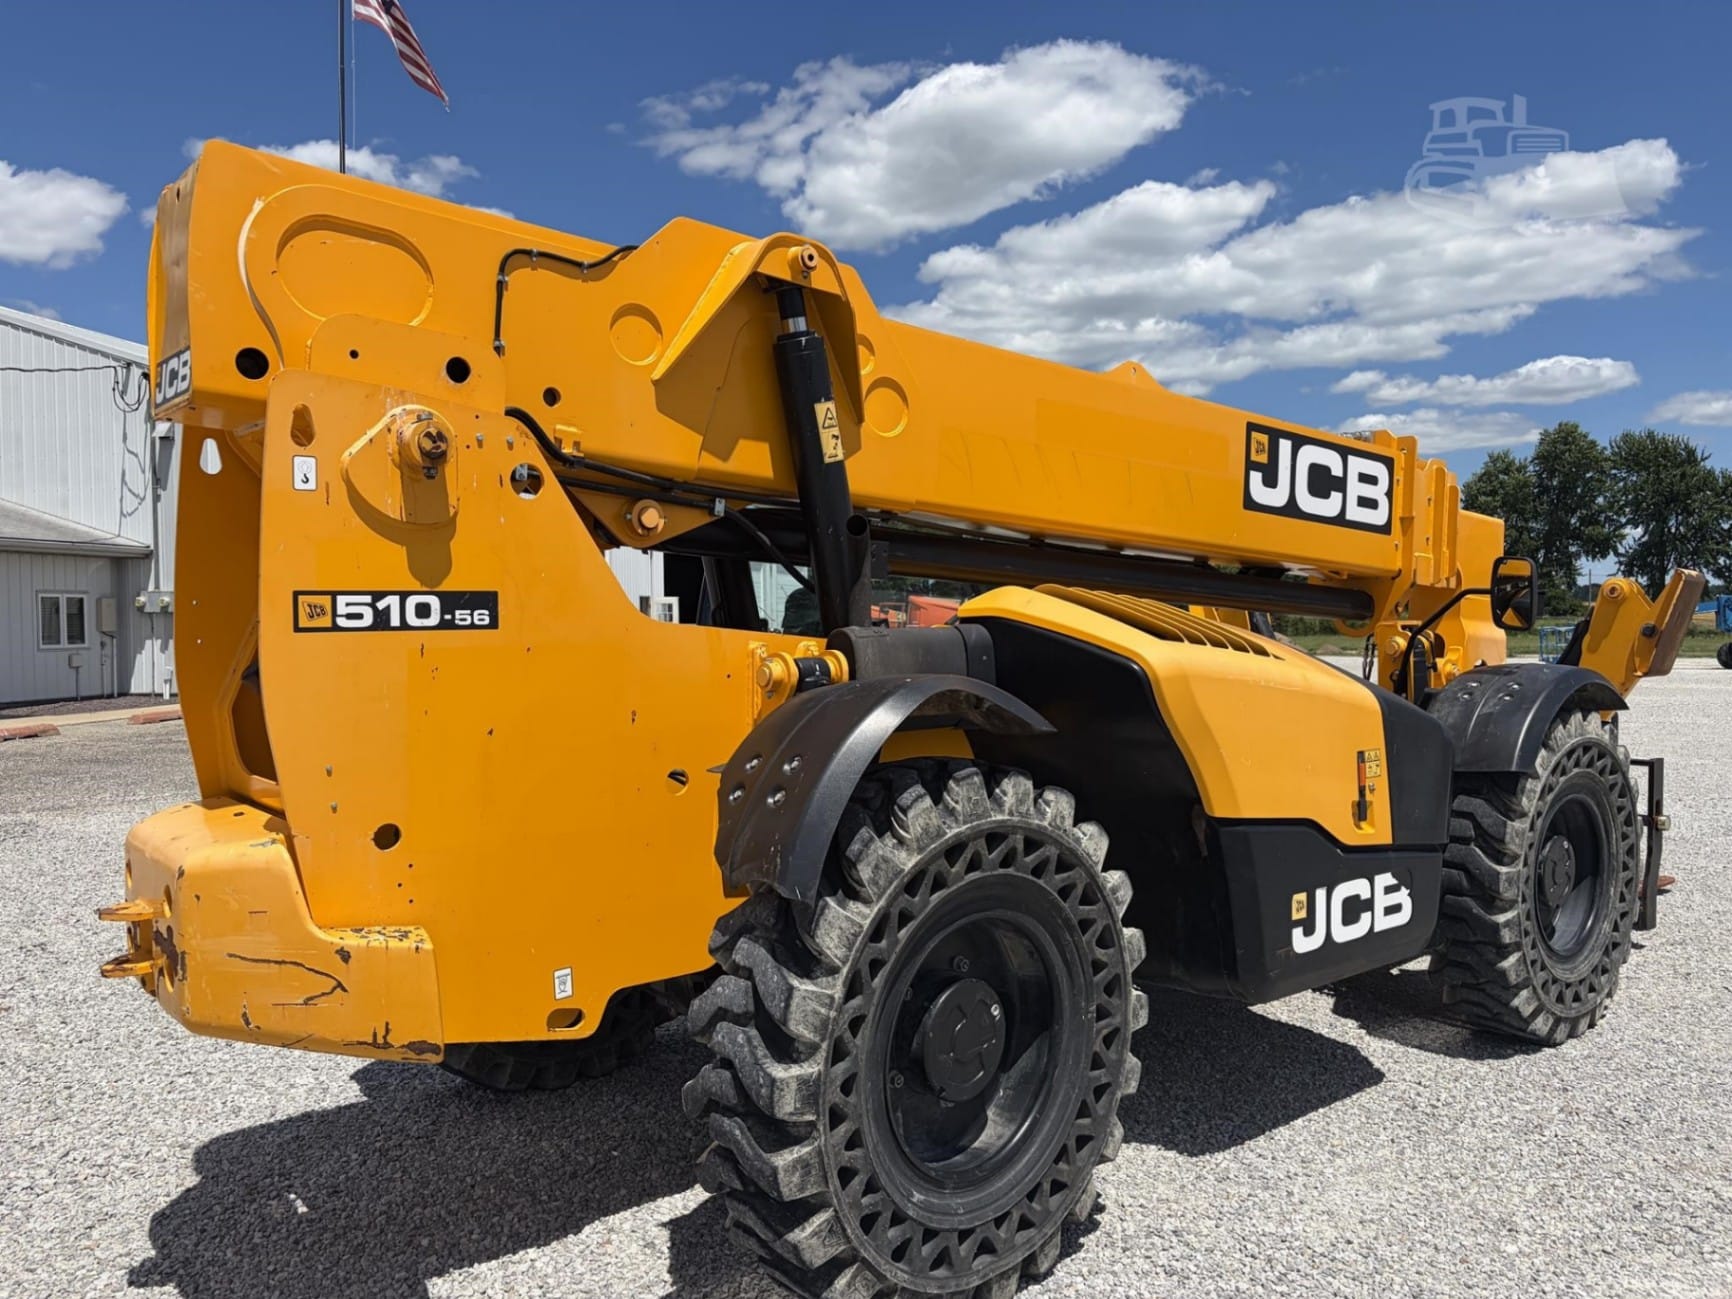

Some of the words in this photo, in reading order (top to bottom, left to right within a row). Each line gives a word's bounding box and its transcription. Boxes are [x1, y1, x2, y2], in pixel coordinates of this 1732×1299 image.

[156, 350, 191, 404] JCB
[1250, 438, 1388, 526] JCB
[306, 603, 327, 618] JCB
[335, 595, 490, 628] 510-56
[1292, 872, 1412, 954] JCB
